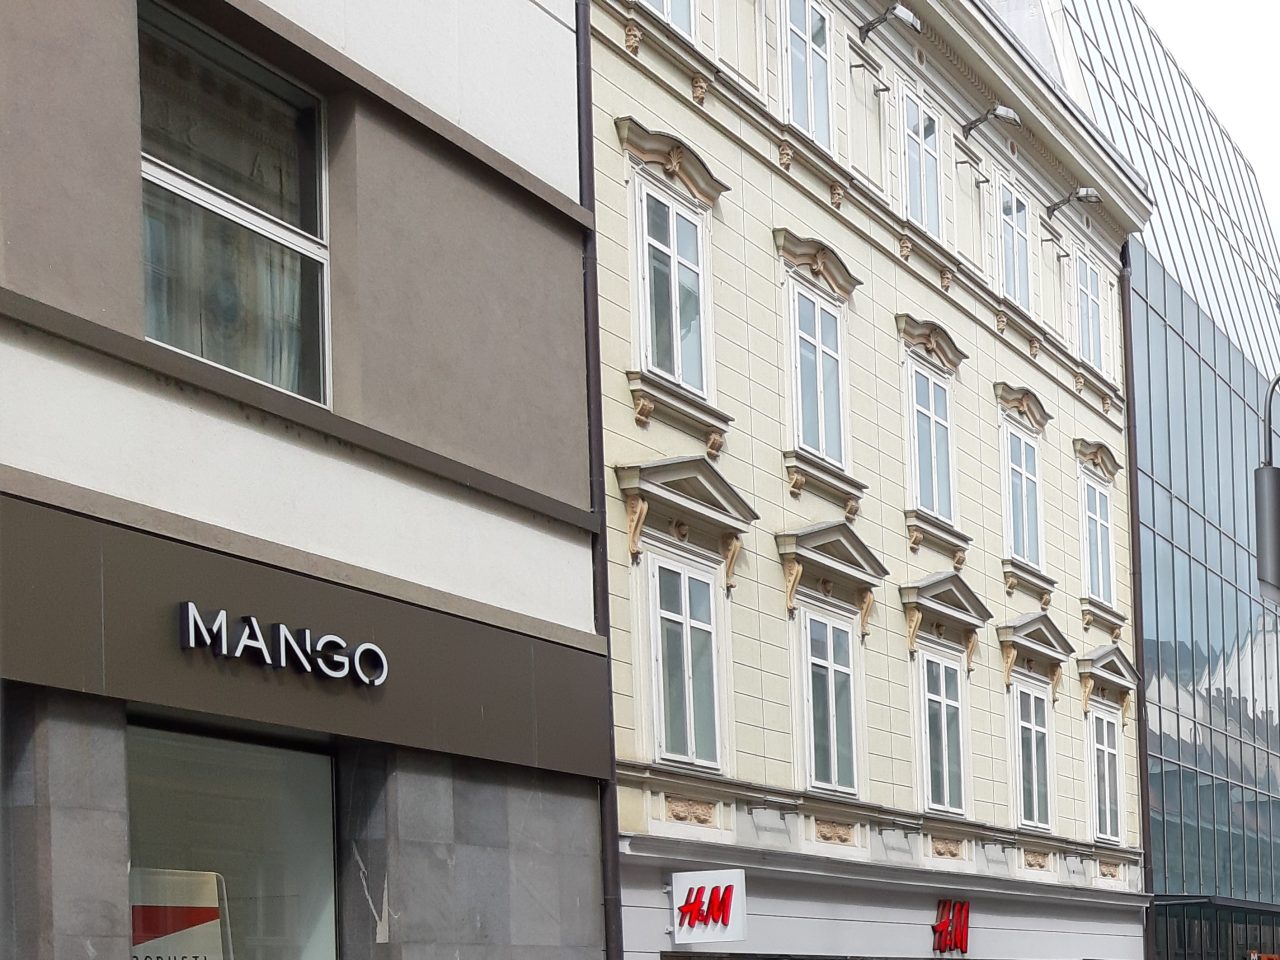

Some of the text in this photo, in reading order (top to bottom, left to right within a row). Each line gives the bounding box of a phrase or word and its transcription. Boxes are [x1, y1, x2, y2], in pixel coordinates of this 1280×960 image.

[184, 601, 389, 687] MANGO
[678, 884, 734, 928] H&M
[931, 899, 970, 954] H&M
